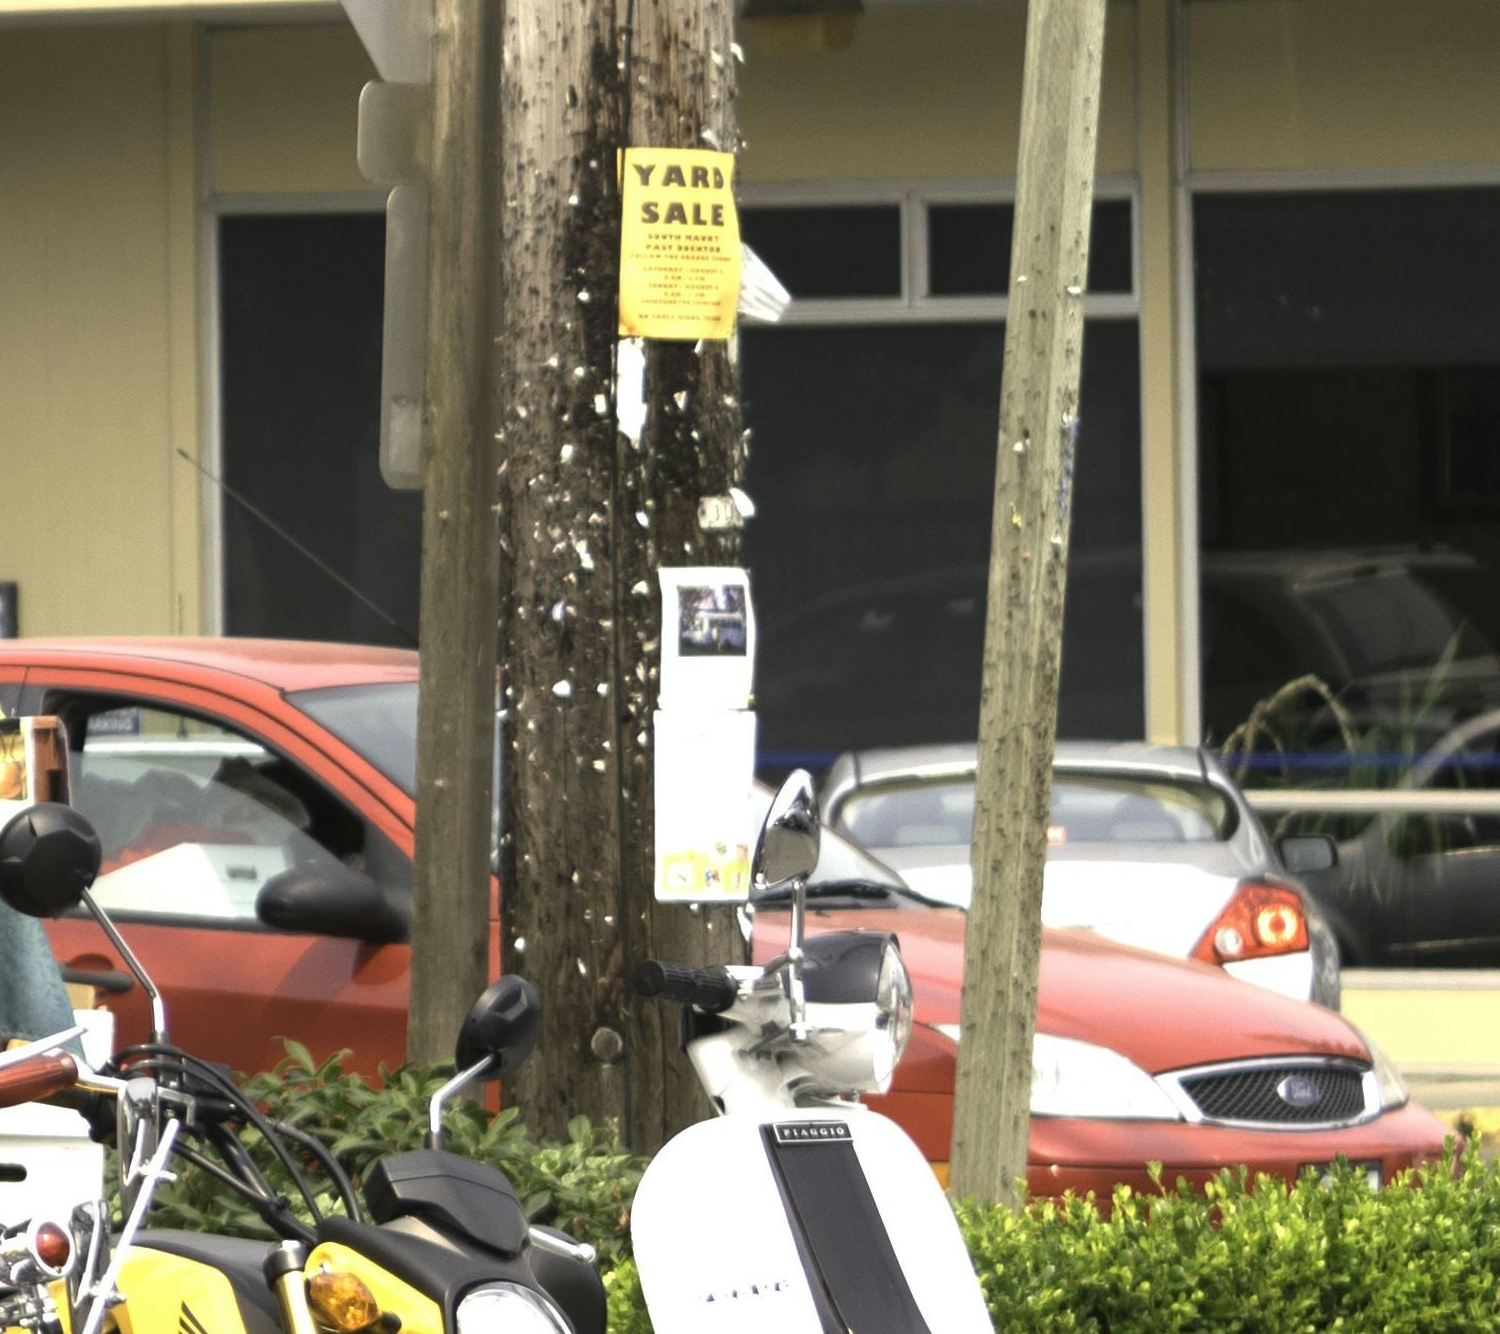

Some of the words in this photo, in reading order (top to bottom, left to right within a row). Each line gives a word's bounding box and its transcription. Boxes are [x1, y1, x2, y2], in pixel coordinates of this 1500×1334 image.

[633, 164, 725, 189] YARD
[641, 202, 725, 227] SALE
[783, 1127, 845, 1138] PIAGGIO
